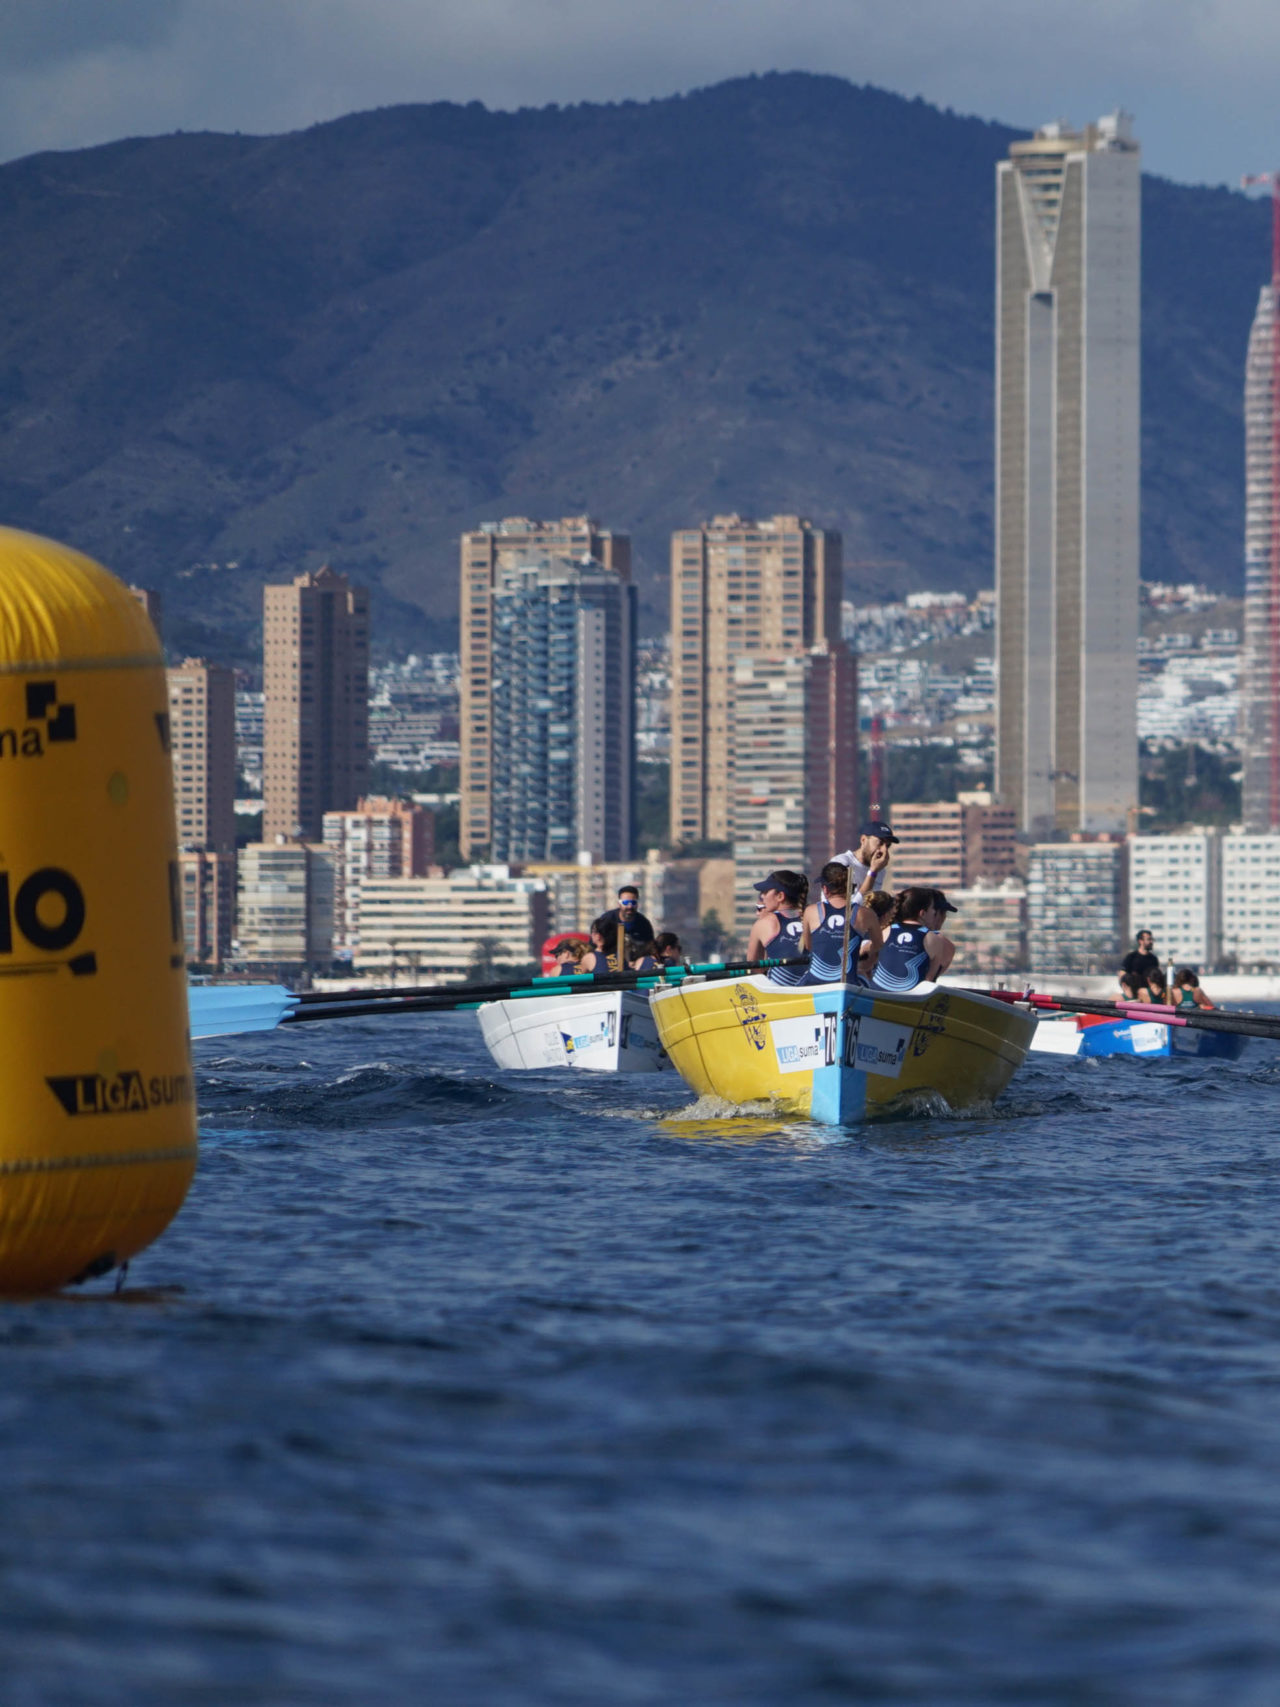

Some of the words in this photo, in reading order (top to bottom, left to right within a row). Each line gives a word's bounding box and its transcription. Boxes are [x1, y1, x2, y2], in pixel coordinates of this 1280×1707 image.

[800, 1044, 819, 1058] suma
[824, 1015, 837, 1065] 76
[877, 1050, 897, 1065] suma
[76, 1074, 146, 1113] LIGA
